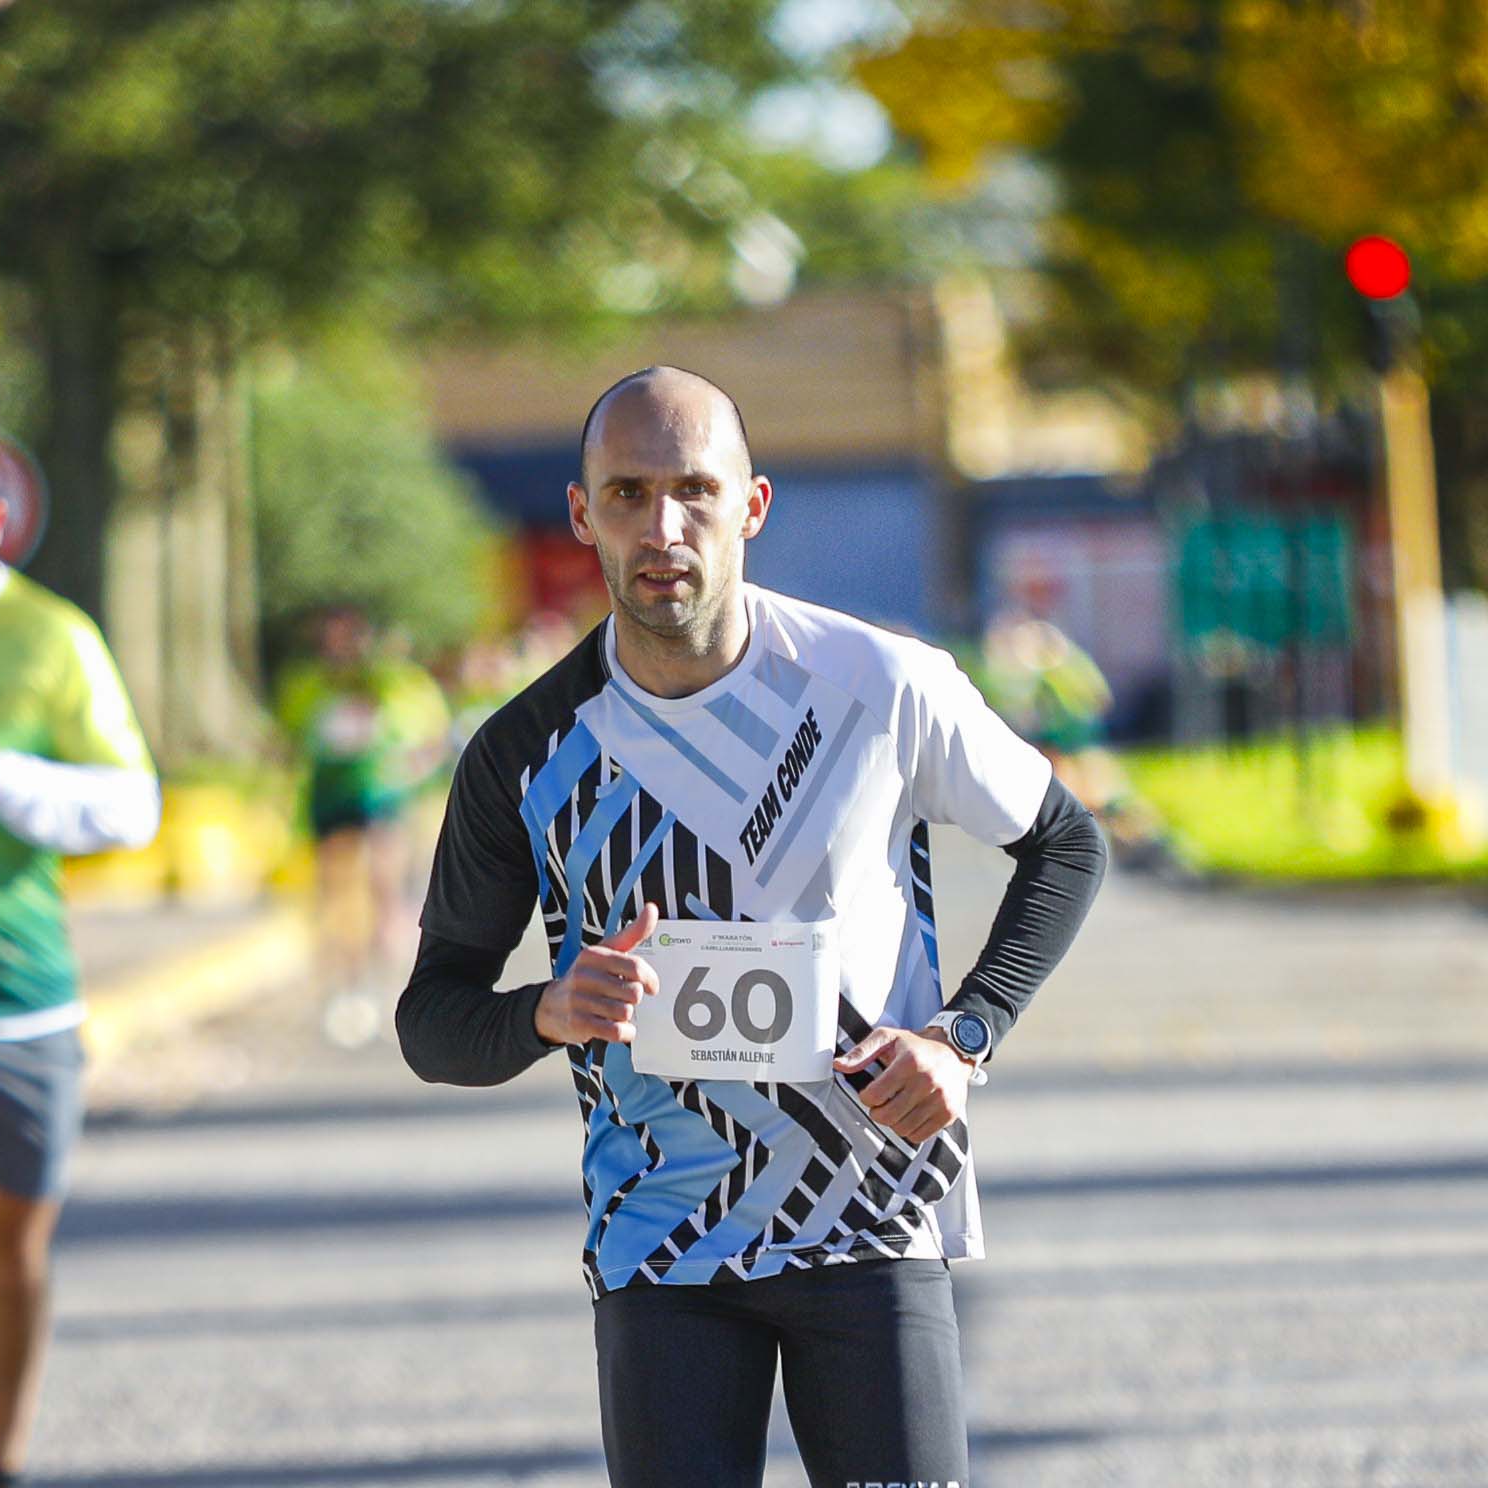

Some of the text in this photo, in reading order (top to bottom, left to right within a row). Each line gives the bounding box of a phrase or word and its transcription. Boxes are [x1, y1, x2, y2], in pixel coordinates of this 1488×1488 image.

[738, 705, 823, 867] TEAM CONDE
[672, 966, 793, 1045] 60
[690, 1048, 776, 1064] SEBASTIÁN ALLENDE
